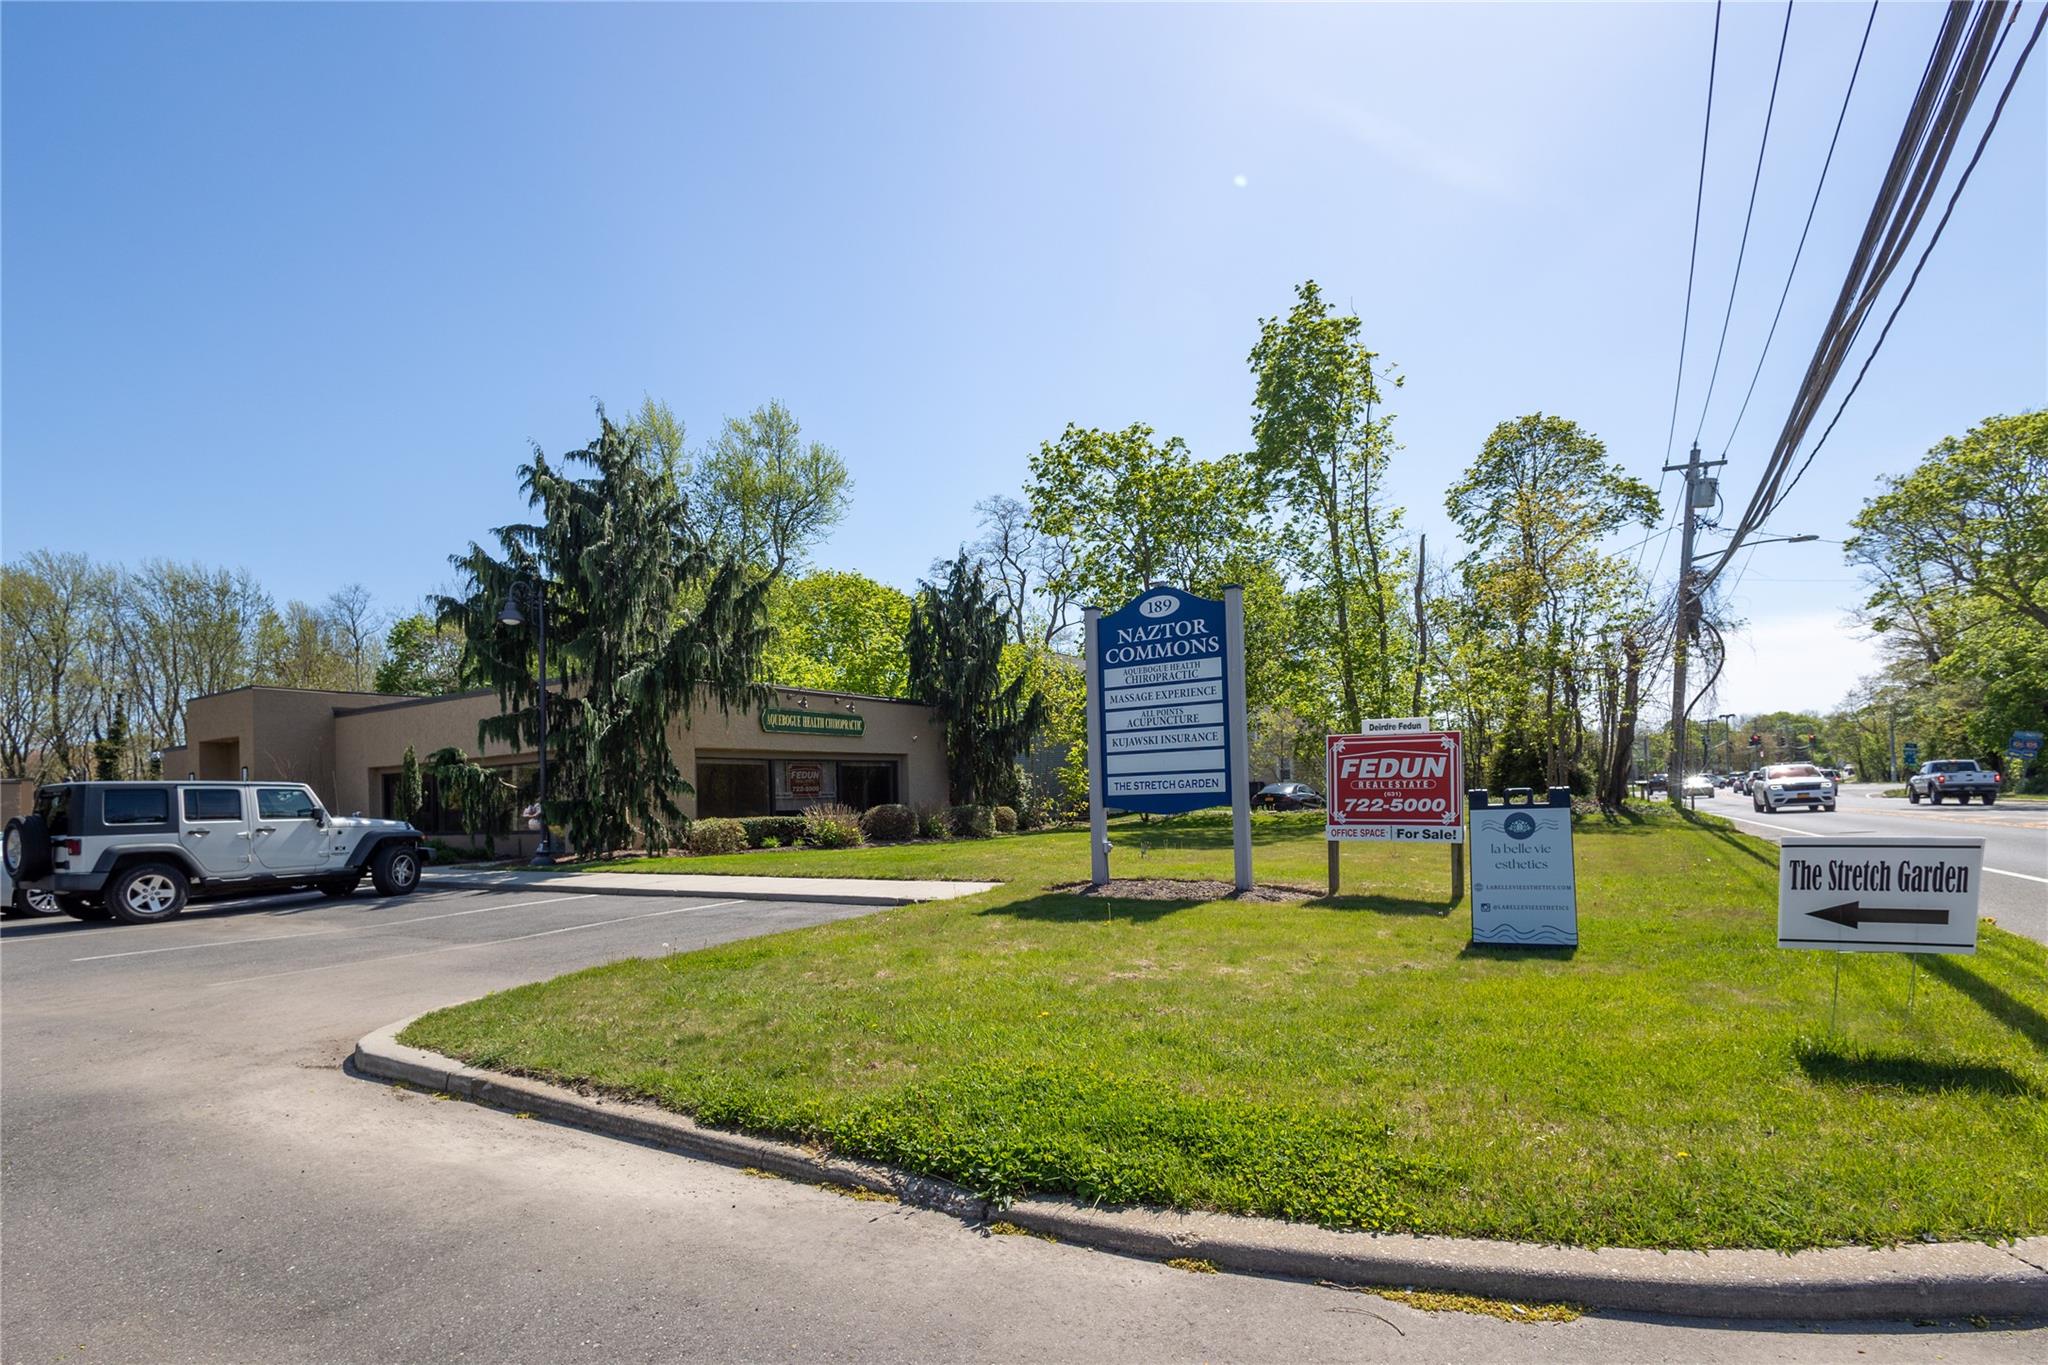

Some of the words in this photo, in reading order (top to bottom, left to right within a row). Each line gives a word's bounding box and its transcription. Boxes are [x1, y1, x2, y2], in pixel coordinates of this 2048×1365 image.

[1149, 599, 1172, 614] 189
[1117, 619, 1208, 644] NAZTOR
[1105, 636, 1219, 664] COMMONS
[1123, 664, 1169, 676] AQUEBOGUE
[1169, 660, 1201, 670] HEALTH
[1125, 669, 1199, 685] CHIROPRACTIC
[1109, 691, 1154, 705] MASSAGE
[1155, 685, 1217, 701] EXPERIENCE
[1141, 710, 1155, 718] ALL
[1156, 708, 1184, 717] POINTS
[1127, 714, 1200, 728] ACUPUNCTURE
[1369, 723, 1397, 731] Deirdre
[1398, 722, 1422, 730] Fedun
[1111, 735, 1159, 748] KUJAWSKI
[1160, 731, 1219, 745] INSURANCE
[791, 771, 819, 779] FEDUN
[1340, 757, 1447, 779] FEDUN
[1114, 781, 1132, 791] THE
[1133, 779, 1176, 791] STRETCH
[1177, 778, 1219, 789] GARDEN
[1358, 780, 1386, 789] REAL
[1388, 780, 1429, 789] ESTATE
[1344, 798, 1446, 812] 722-5000
[1331, 829, 1358, 837] OFFICE
[1361, 829, 1386, 837] SPACE
[1396, 829, 1420, 839] For
[1422, 829, 1457, 840] Sale!
[1491, 843, 1501, 854] la
[1503, 843, 1532, 854] belle
[1534, 844, 1551, 854] vie
[1495, 859, 1549, 870] esthetics
[1790, 859, 1822, 891] The
[1828, 859, 1891, 892] Stretch
[1897, 860, 1969, 893] Garden
